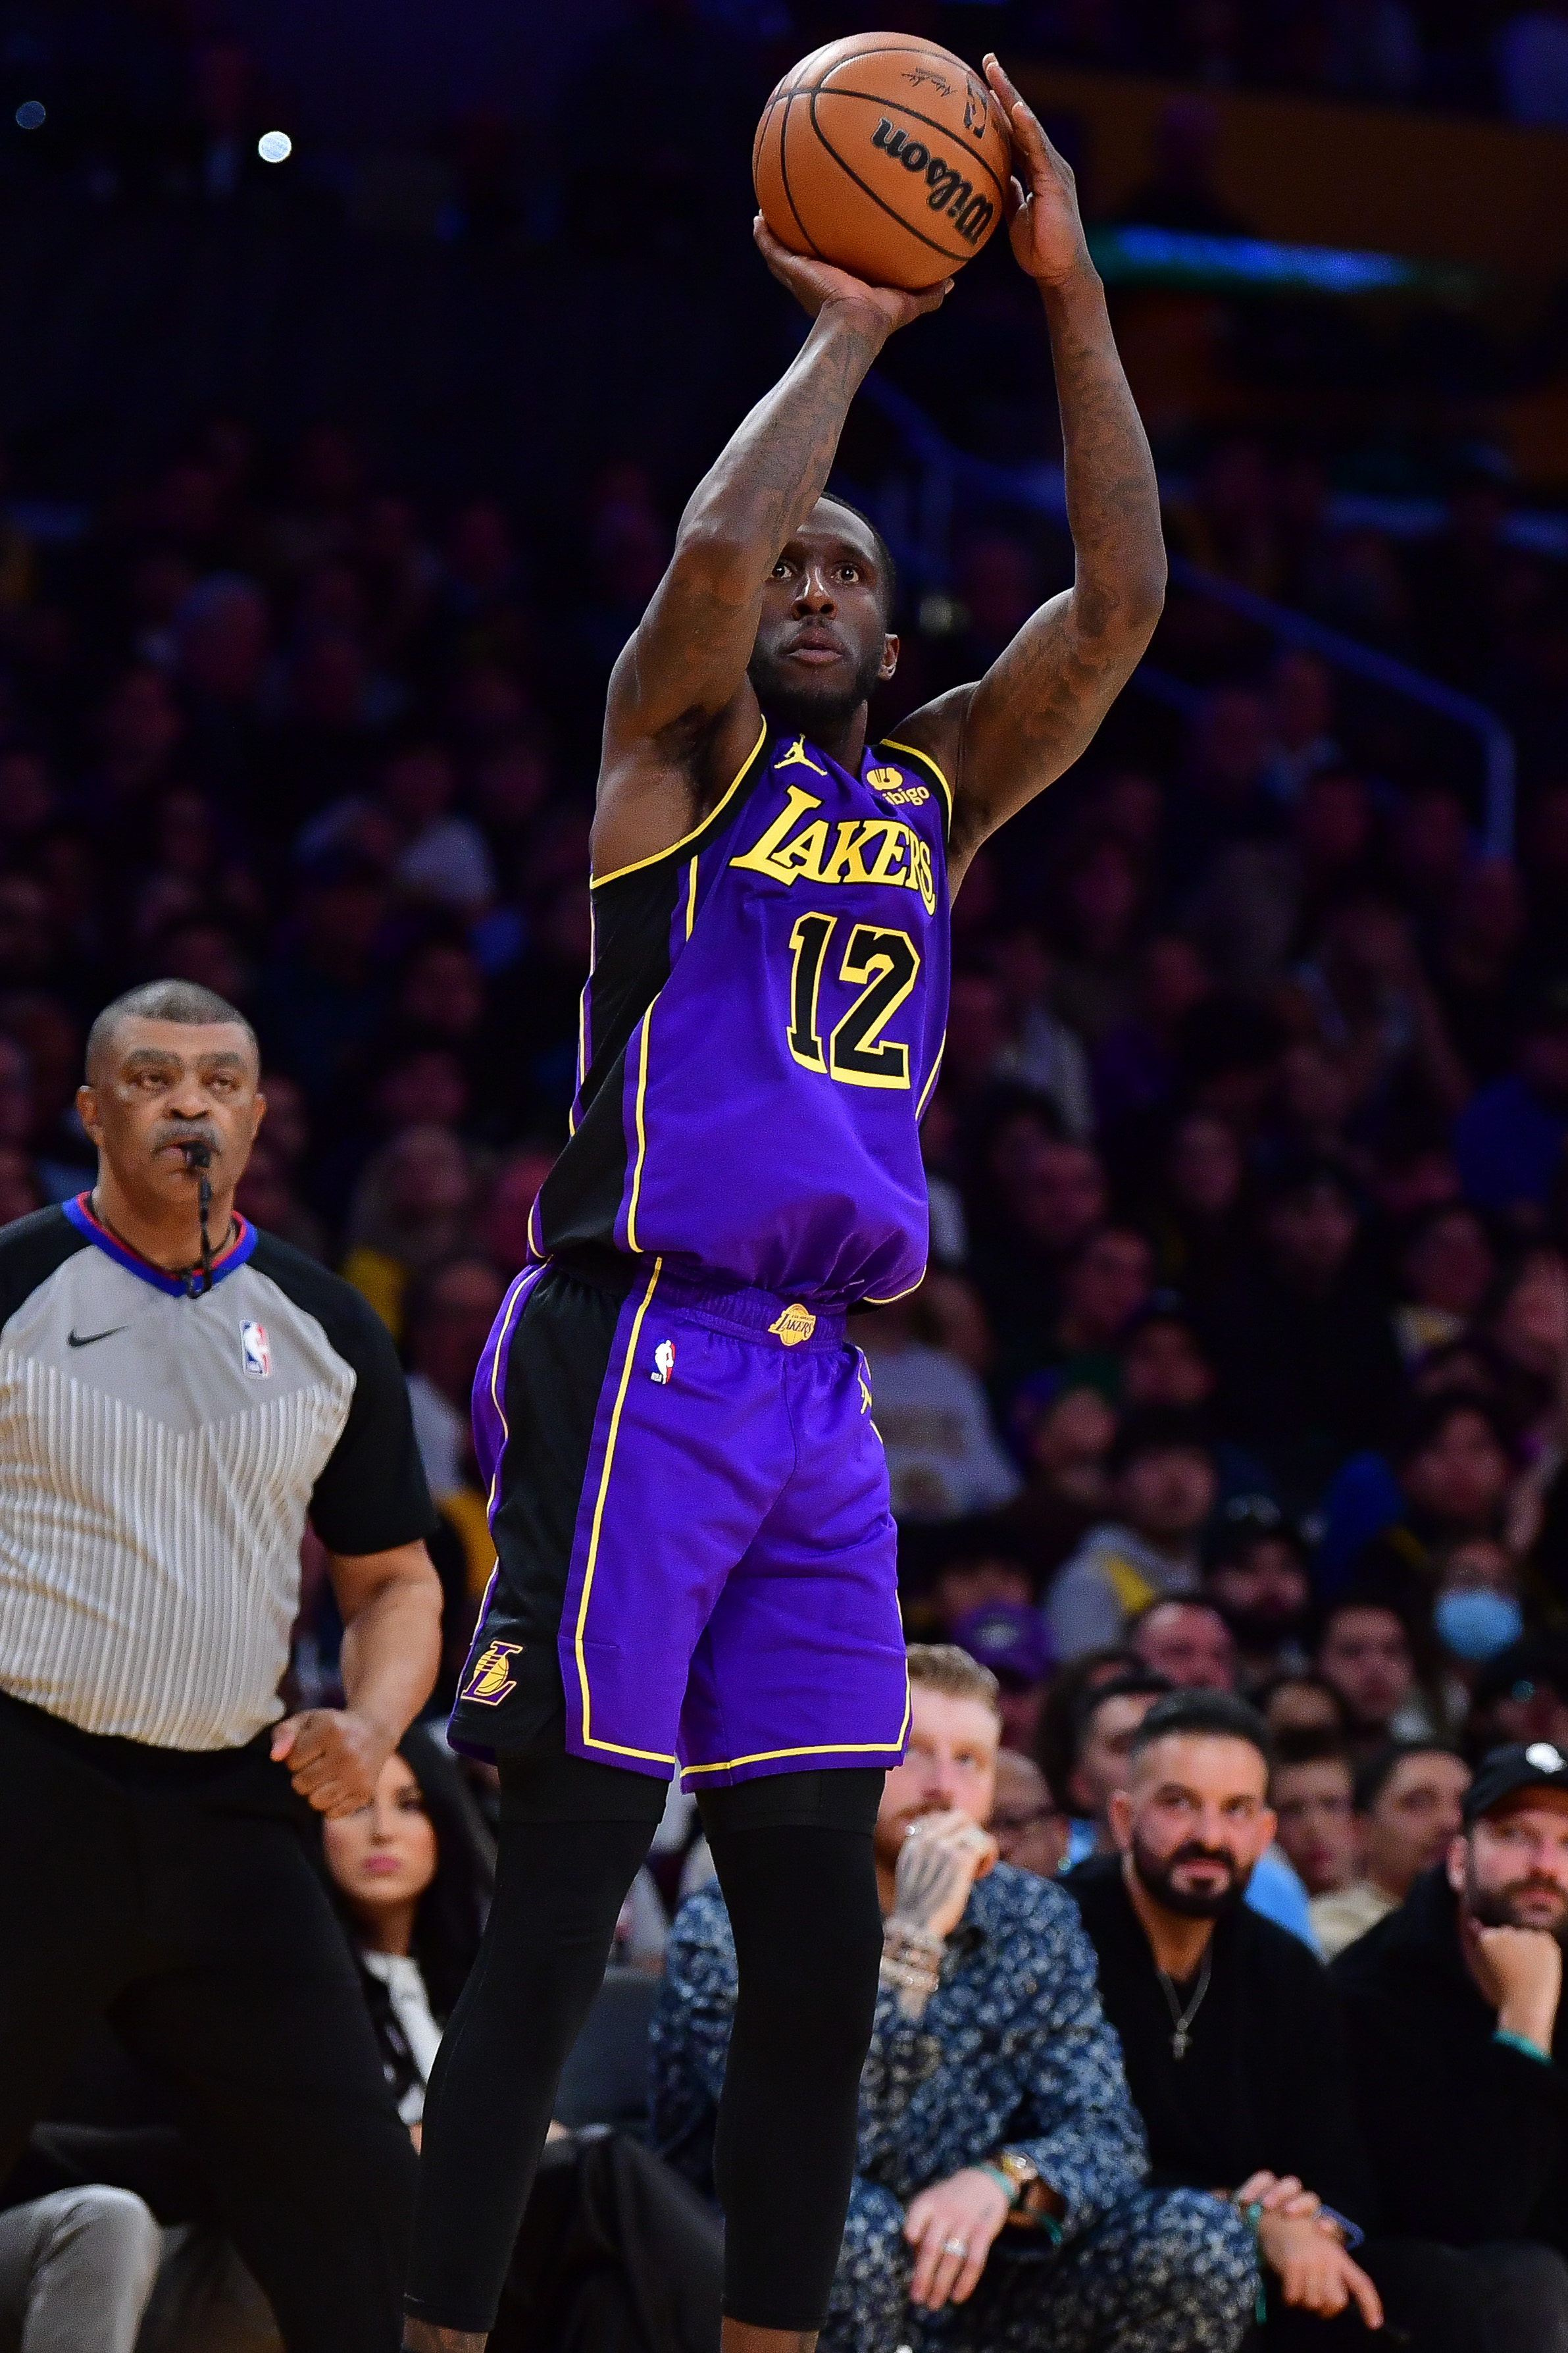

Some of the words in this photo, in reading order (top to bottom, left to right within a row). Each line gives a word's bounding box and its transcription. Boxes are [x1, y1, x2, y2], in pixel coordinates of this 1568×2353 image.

[871, 116, 994, 246] Wilson
[729, 785, 936, 916] LAKERS
[882, 787, 930, 806] ibigo
[787, 912, 920, 1089] 12
[769, 1311, 813, 1338] LAKERS
